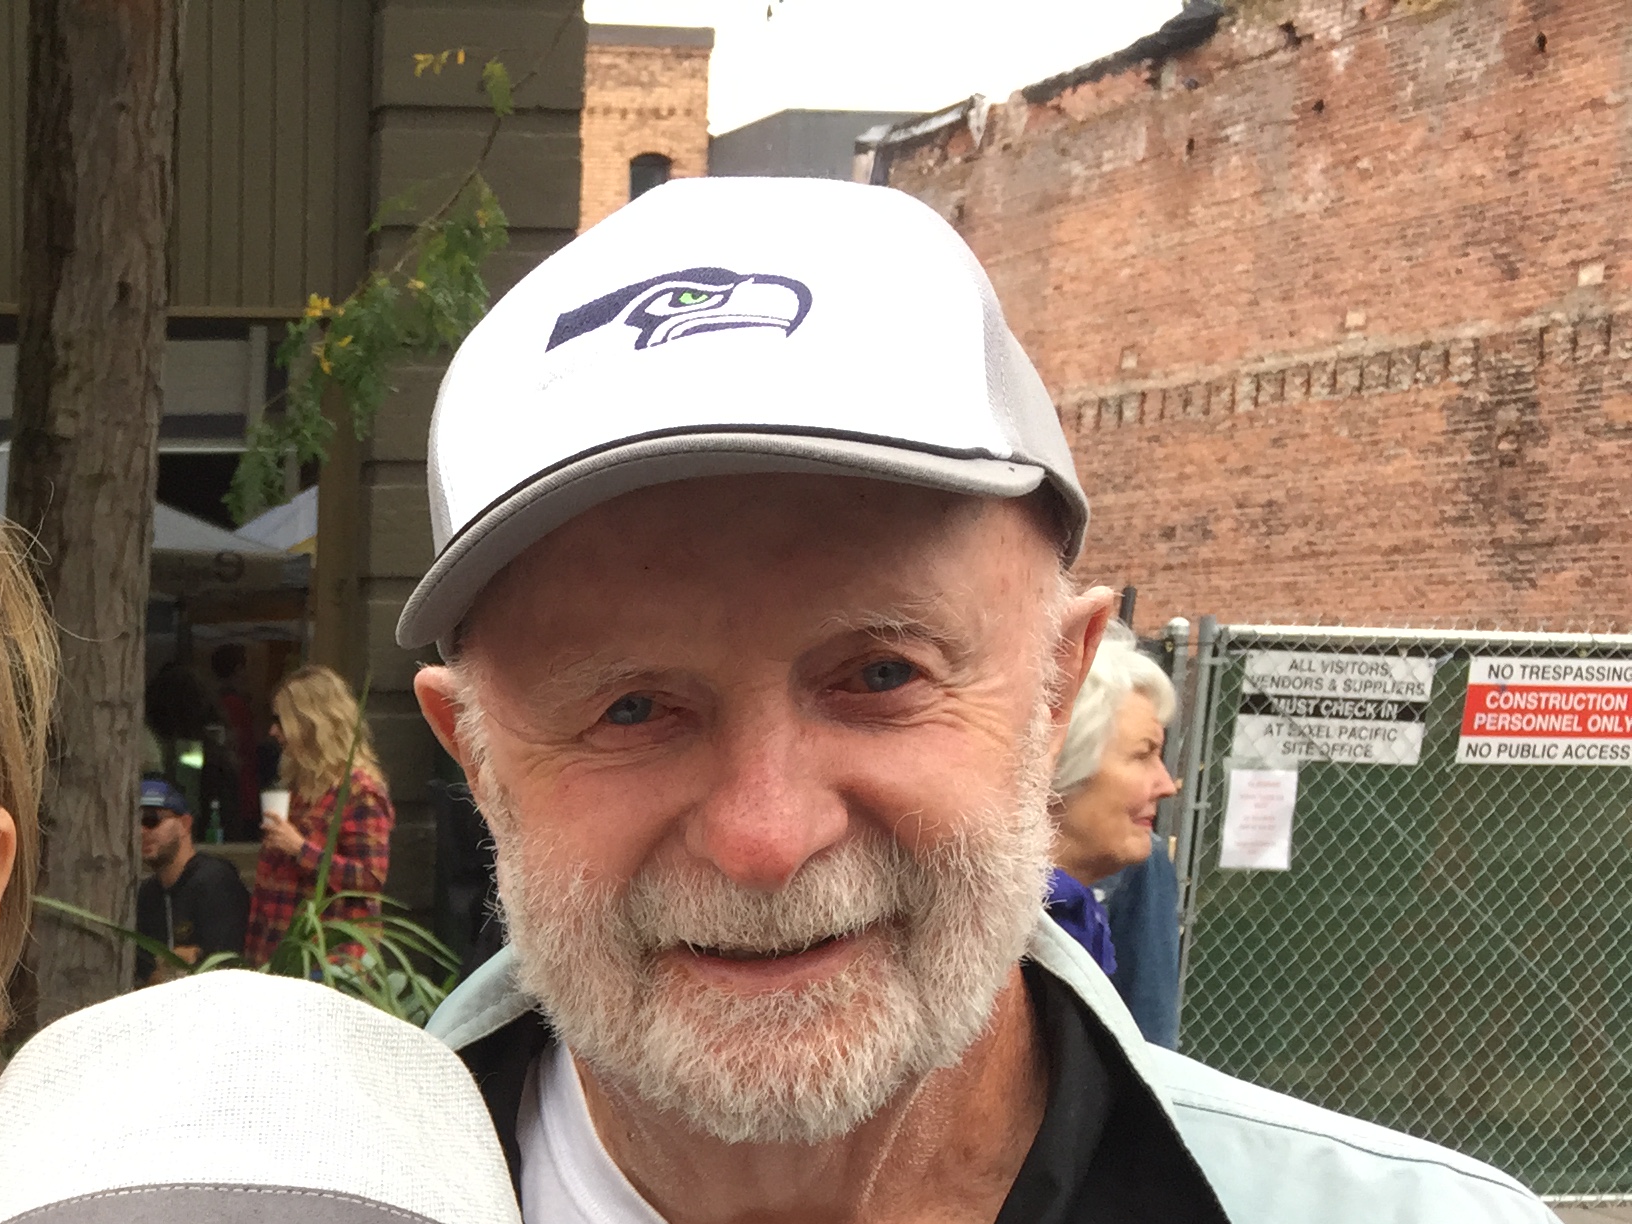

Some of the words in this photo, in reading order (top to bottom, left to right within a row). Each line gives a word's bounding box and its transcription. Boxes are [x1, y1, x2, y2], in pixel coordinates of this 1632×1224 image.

[1289, 659, 1316, 673] ALL
[1487, 663, 1514, 679] NO
[1520, 664, 1632, 682] TRESPASSING
[1251, 675, 1323, 691] VENDORS
[1328, 679, 1337, 691] &
[1342, 678, 1425, 695] SUPPLIERS
[1270, 698, 1318, 714] MUST
[1320, 700, 1376, 717] CHECK
[1379, 702, 1399, 719] IN
[1485, 691, 1628, 711] CONSTRUCTION
[1473, 712, 1583, 732] PERSONNEL
[1587, 714, 1632, 733] ONLY
[1264, 723, 1283, 737] AT
[1338, 726, 1398, 742] PACIFIC
[1281, 741, 1315, 756] SITE
[1320, 742, 1374, 758] OFFICE
[1465, 742, 1492, 758] NO
[1497, 743, 1559, 759] PUBLIC
[1562, 744, 1630, 760] ACCESS
